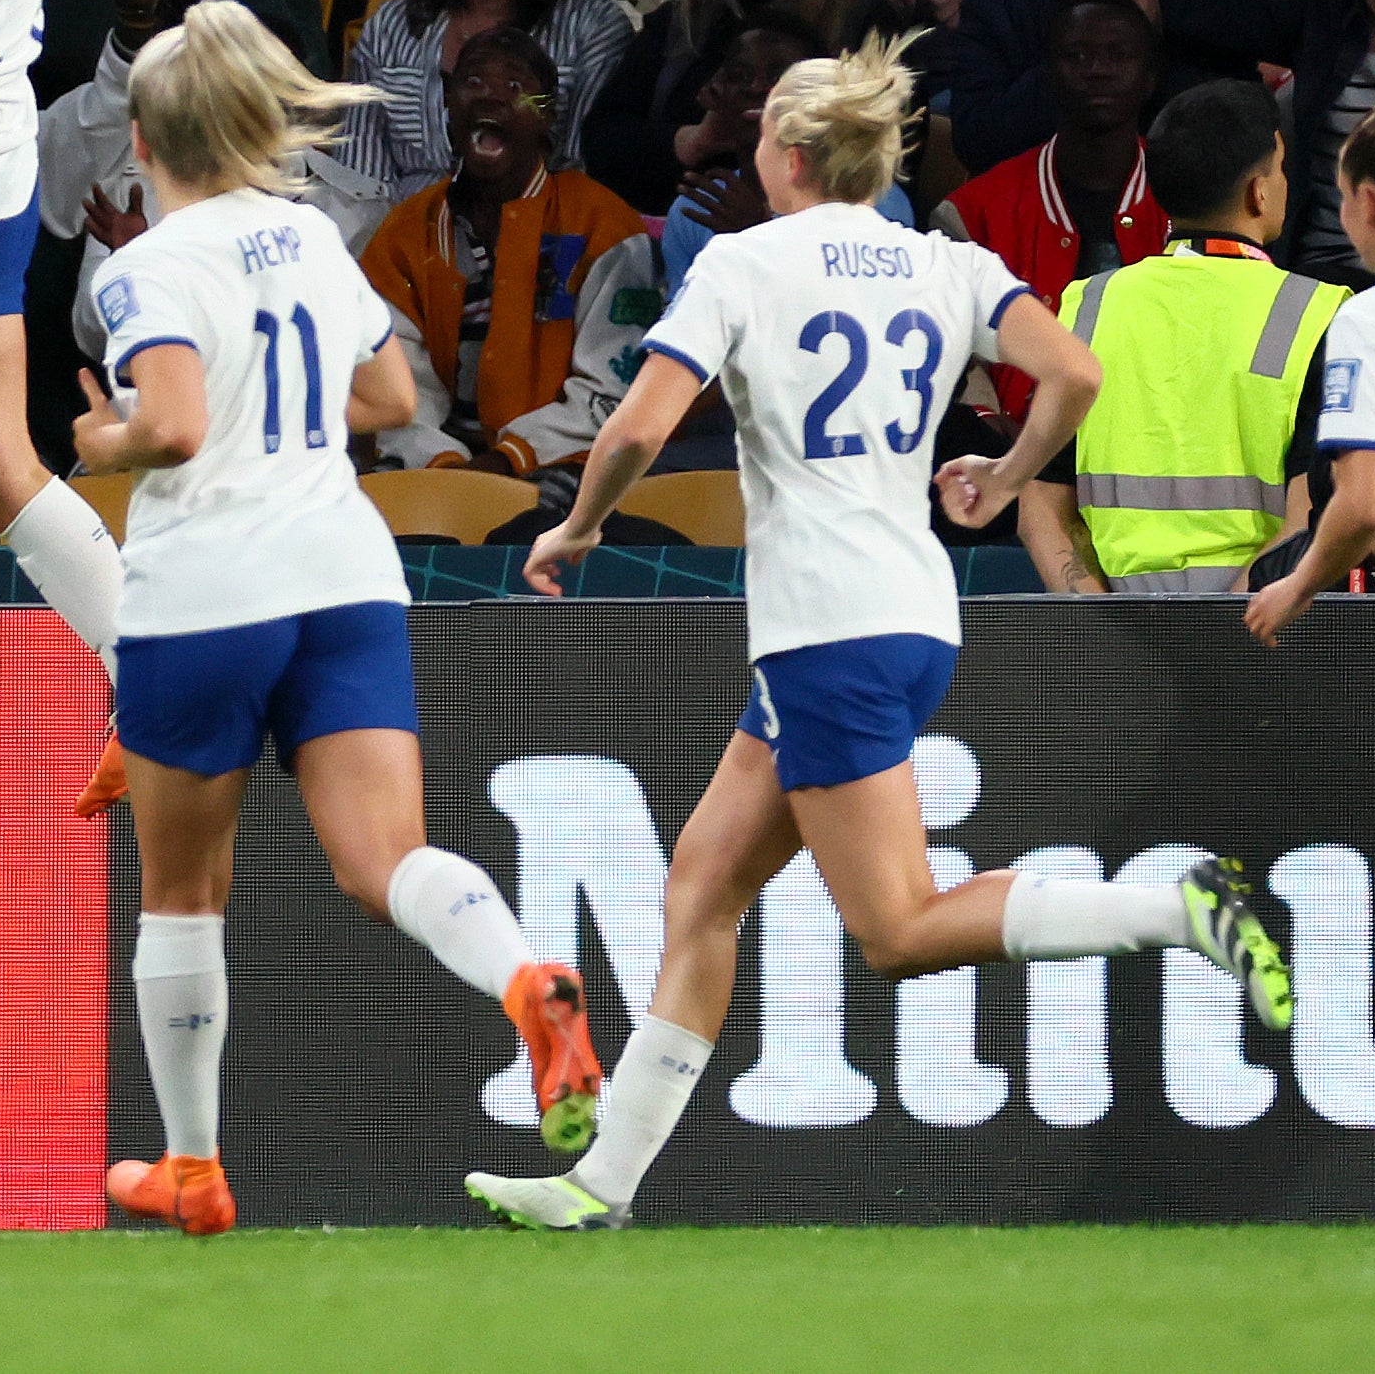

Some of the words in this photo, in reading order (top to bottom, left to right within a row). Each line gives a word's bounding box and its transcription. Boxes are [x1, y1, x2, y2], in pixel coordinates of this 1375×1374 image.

[236, 225, 302, 274] HEMP
[821, 240, 914, 278] RUSSO
[254, 301, 328, 454] 11
[798, 309, 943, 460] 23
